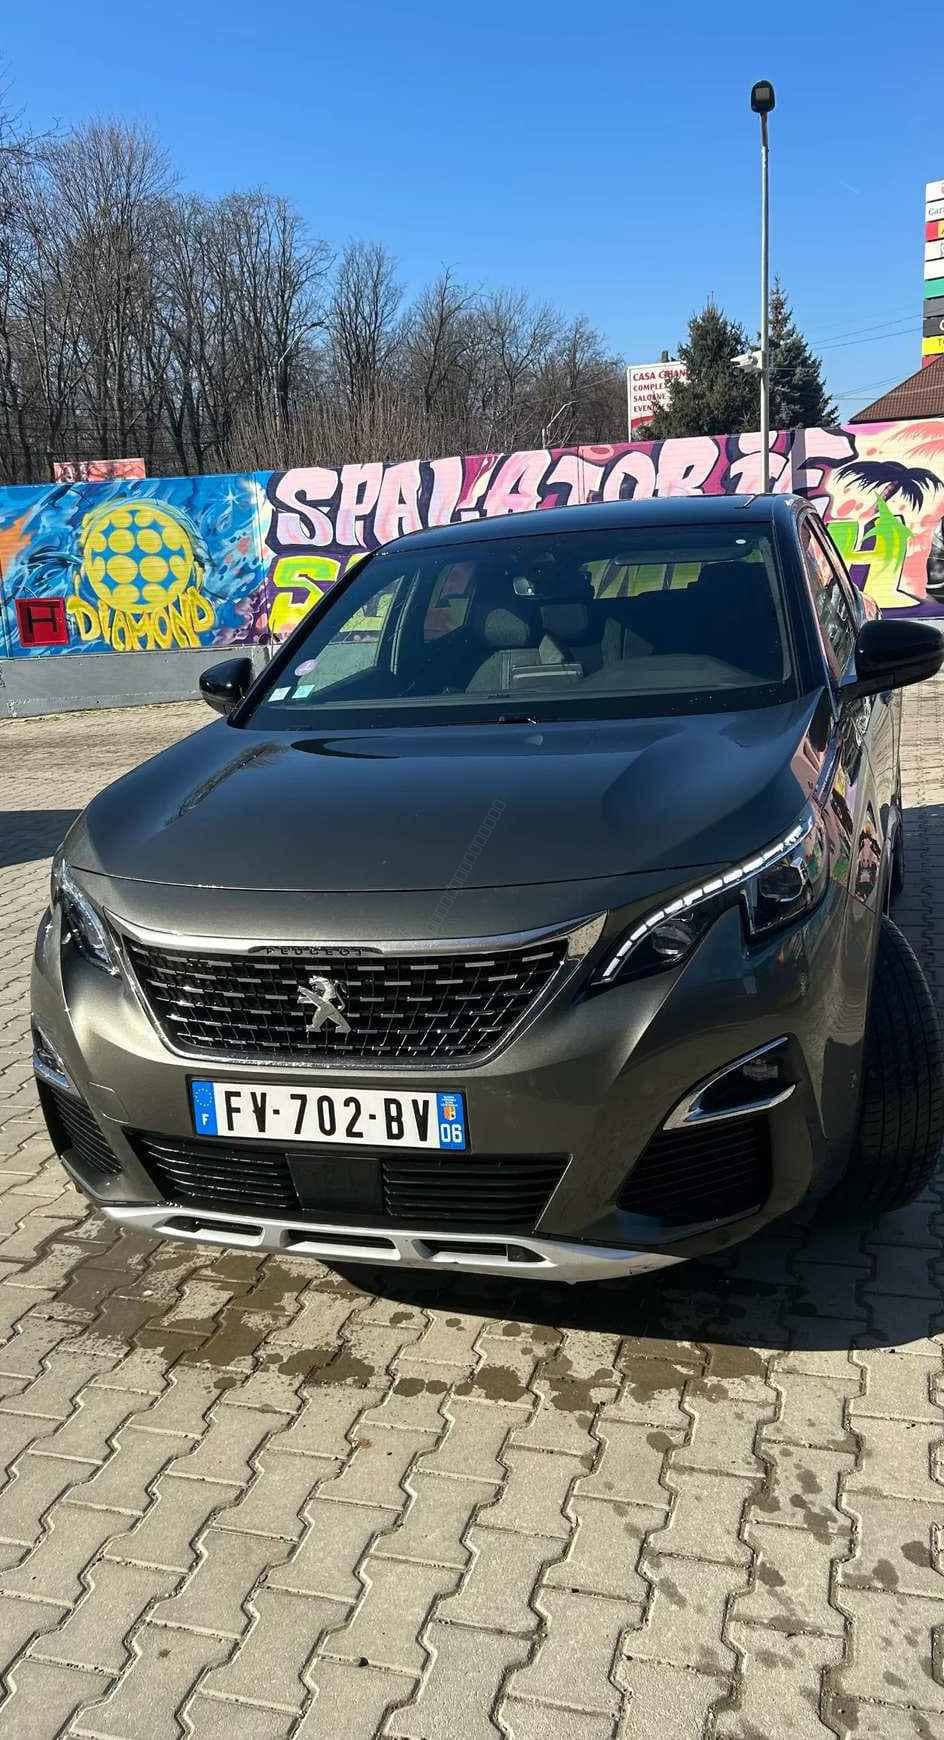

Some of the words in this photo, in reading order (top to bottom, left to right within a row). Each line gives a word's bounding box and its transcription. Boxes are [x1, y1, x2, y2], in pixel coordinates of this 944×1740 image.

[633, 372, 656, 382] CASA
[67, 587, 215, 651] DIAMOND
[266, 945, 367, 957] PEUGEOT
[200, 1113, 209, 1126] F
[224, 1090, 430, 1142] FV-702-BV
[440, 1123, 462, 1143] 06
